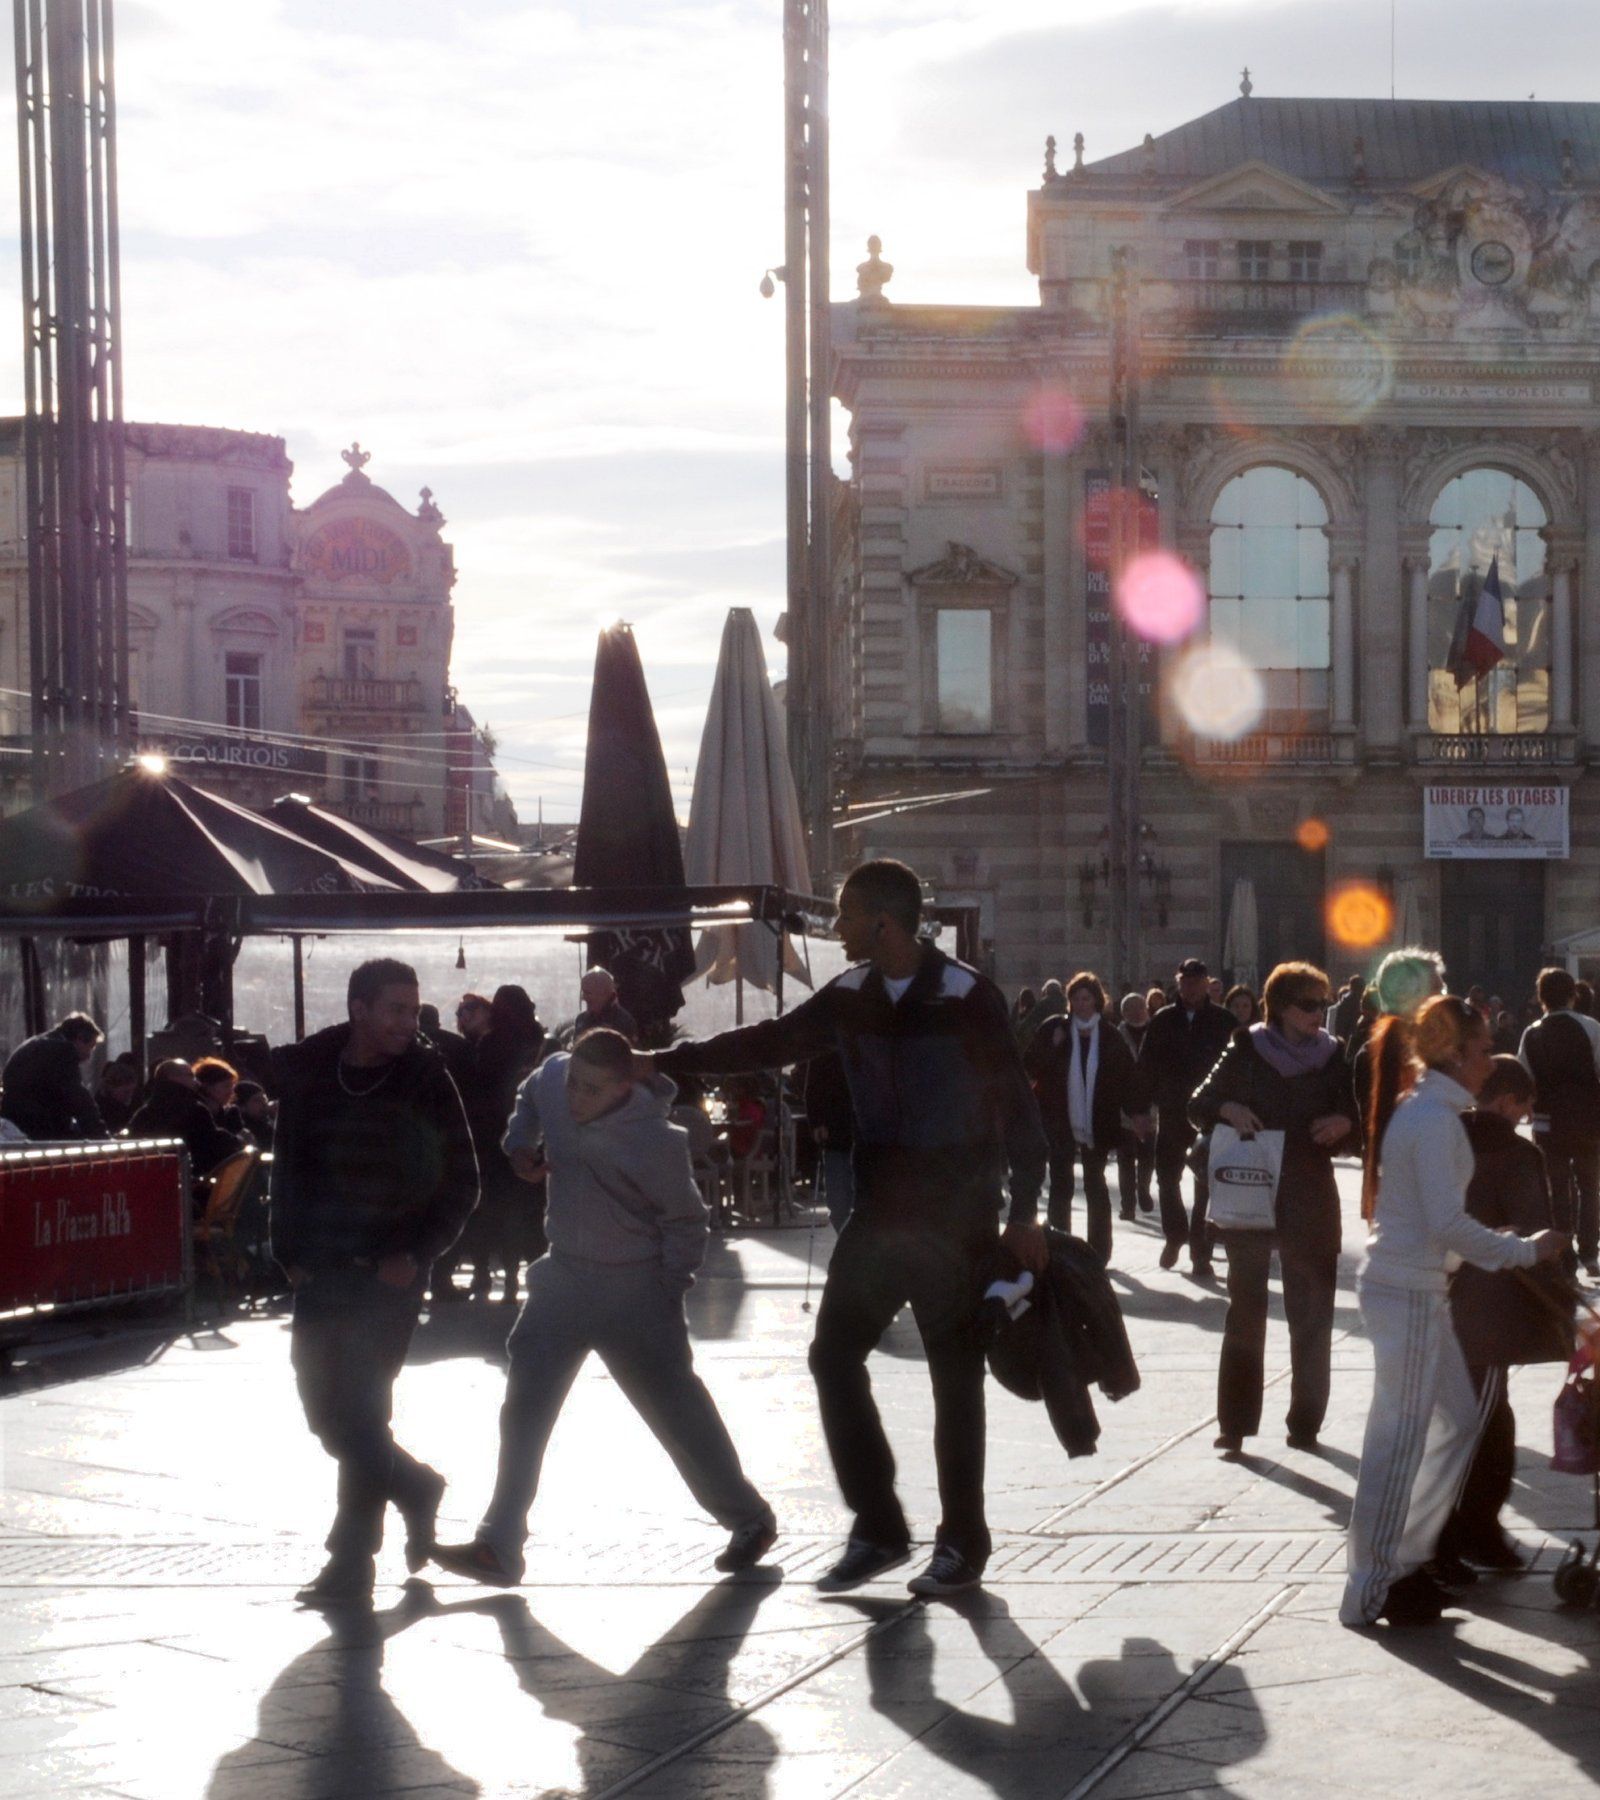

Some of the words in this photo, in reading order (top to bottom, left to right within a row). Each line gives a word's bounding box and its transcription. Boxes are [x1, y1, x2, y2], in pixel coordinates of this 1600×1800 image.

[331, 546, 387, 571] MIDI
[174, 744, 289, 767] COURTOIS
[1430, 789, 1479, 805] LIBEREZ
[1483, 789, 1504, 805] LES
[1507, 789, 1556, 805] OTAGES
[33, 1201, 51, 1246] La
